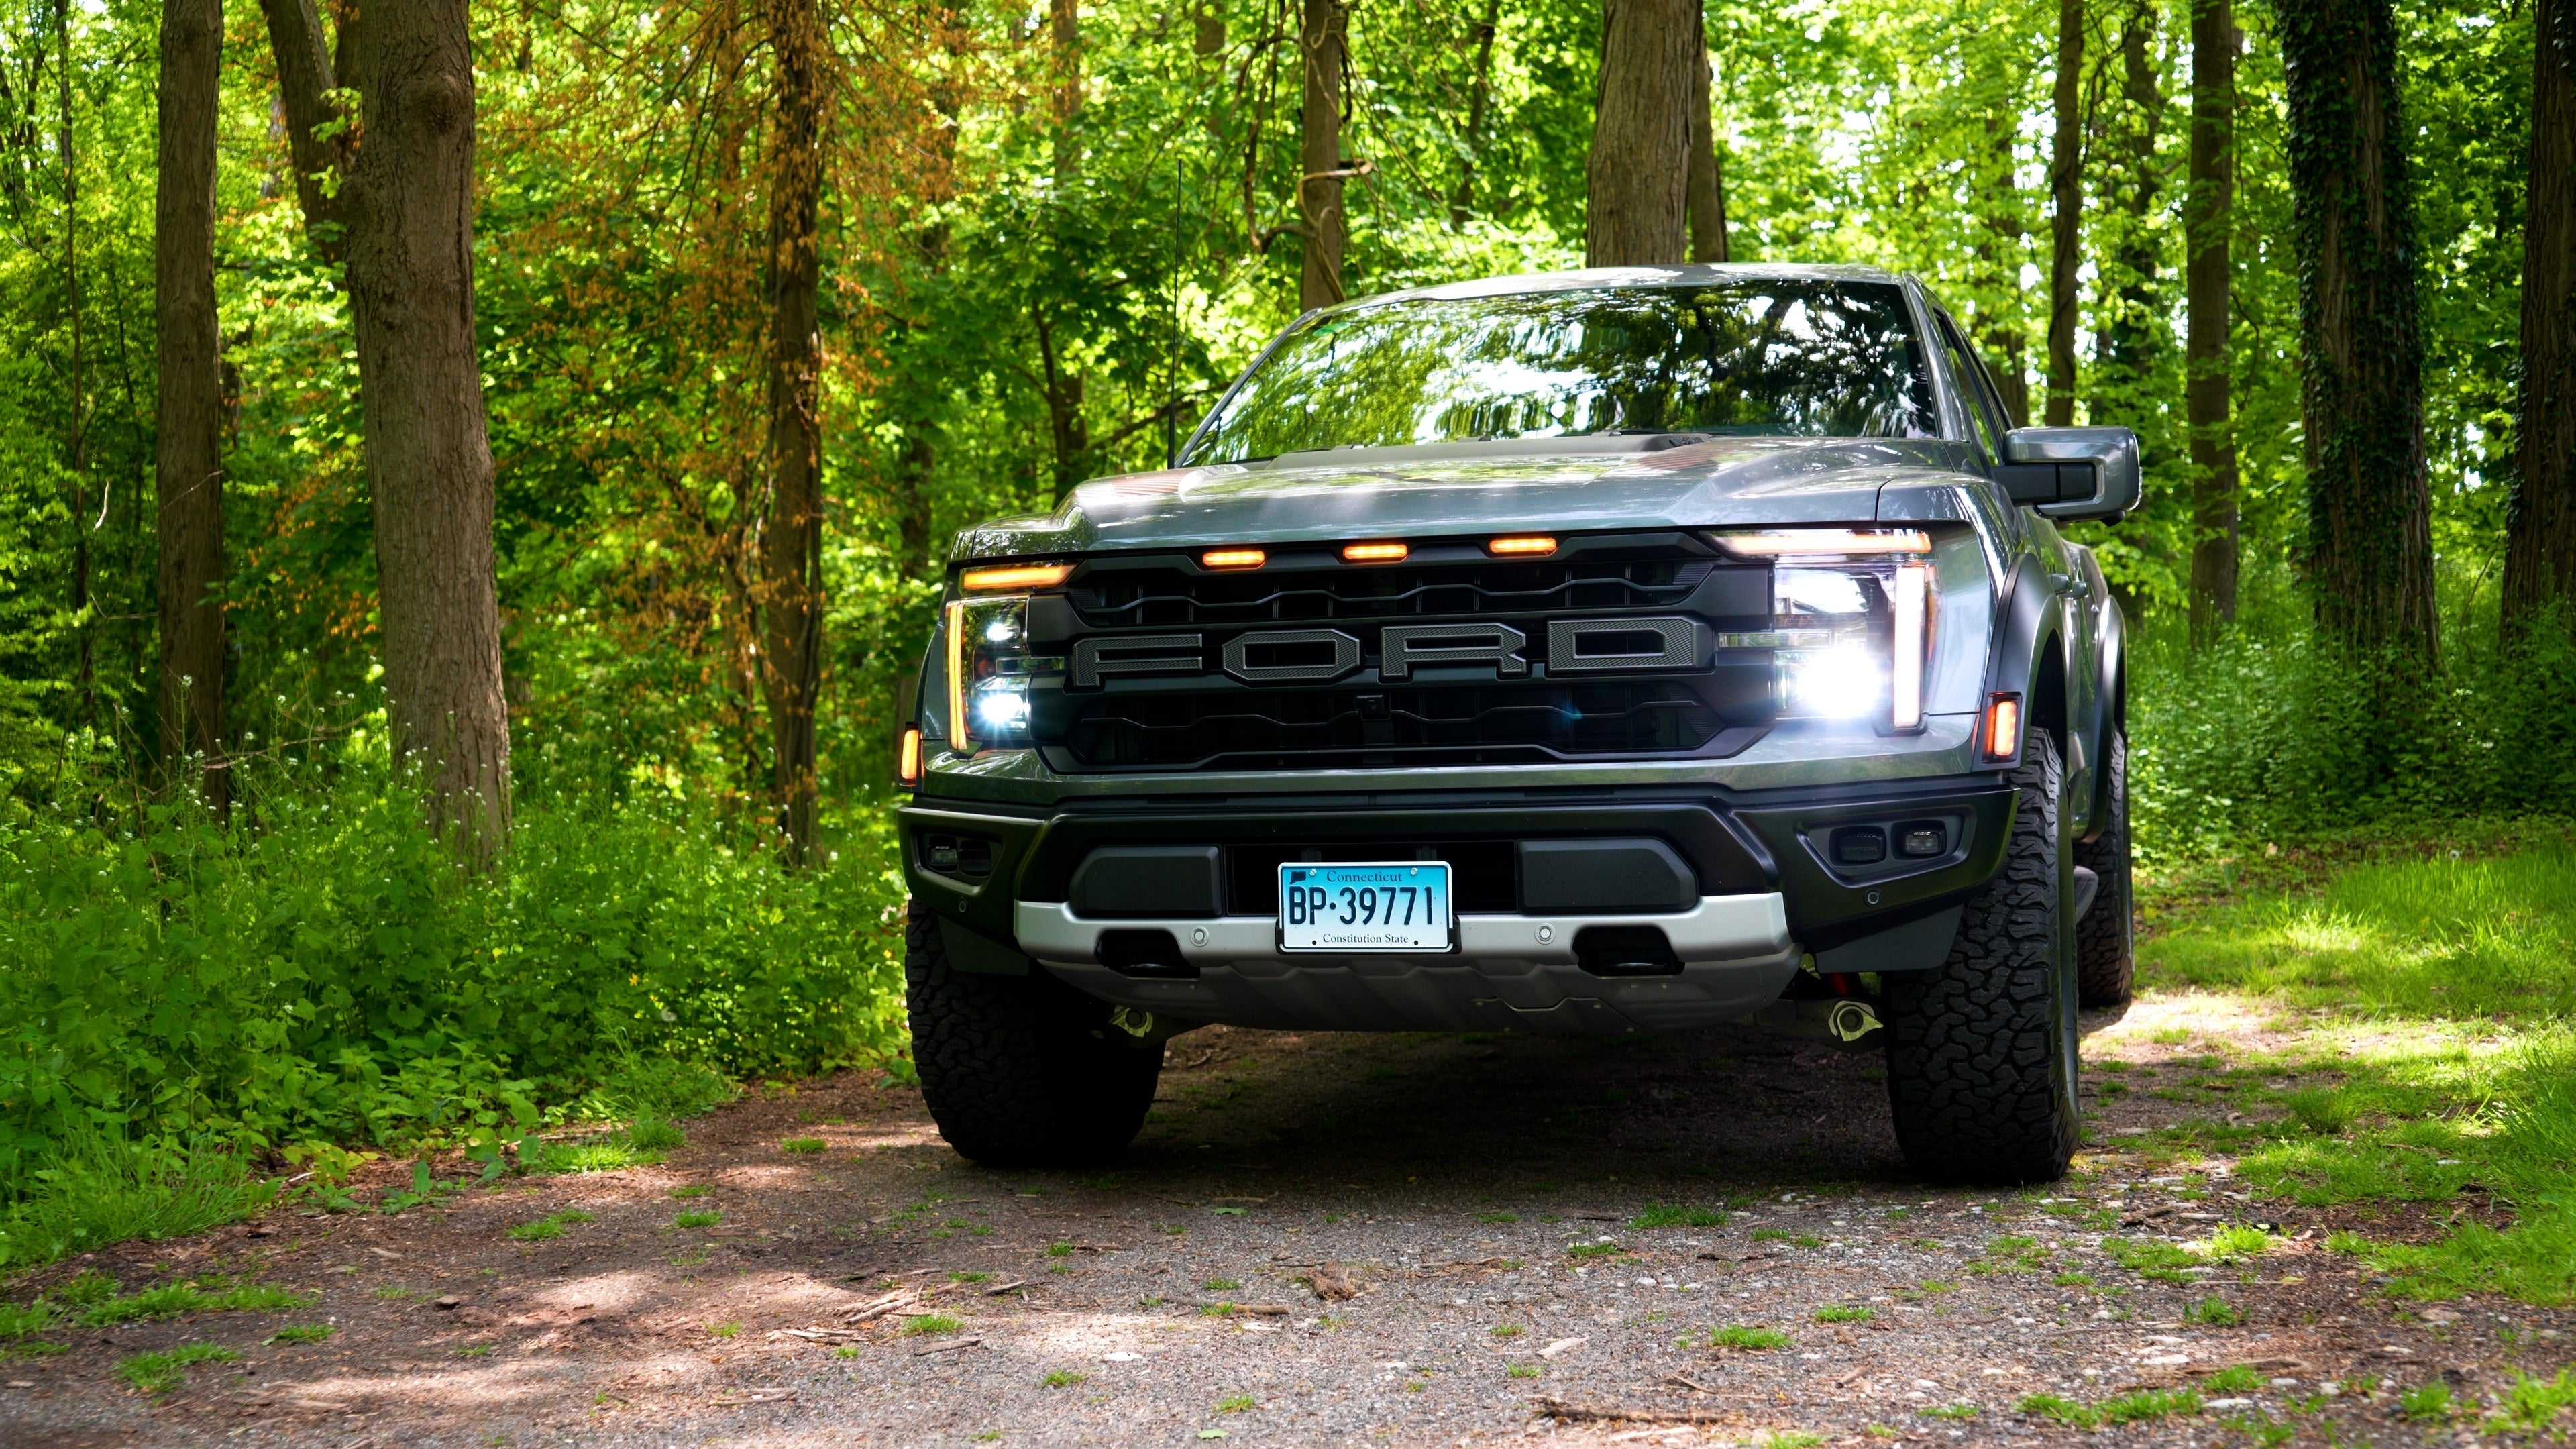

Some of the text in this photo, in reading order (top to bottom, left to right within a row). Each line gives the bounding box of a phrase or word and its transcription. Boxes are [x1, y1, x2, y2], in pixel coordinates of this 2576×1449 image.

[1073, 616, 1695, 687] FORD
[1326, 870, 1403, 882] Connecticut
[1322, 933, 1409, 943] Constitution State
